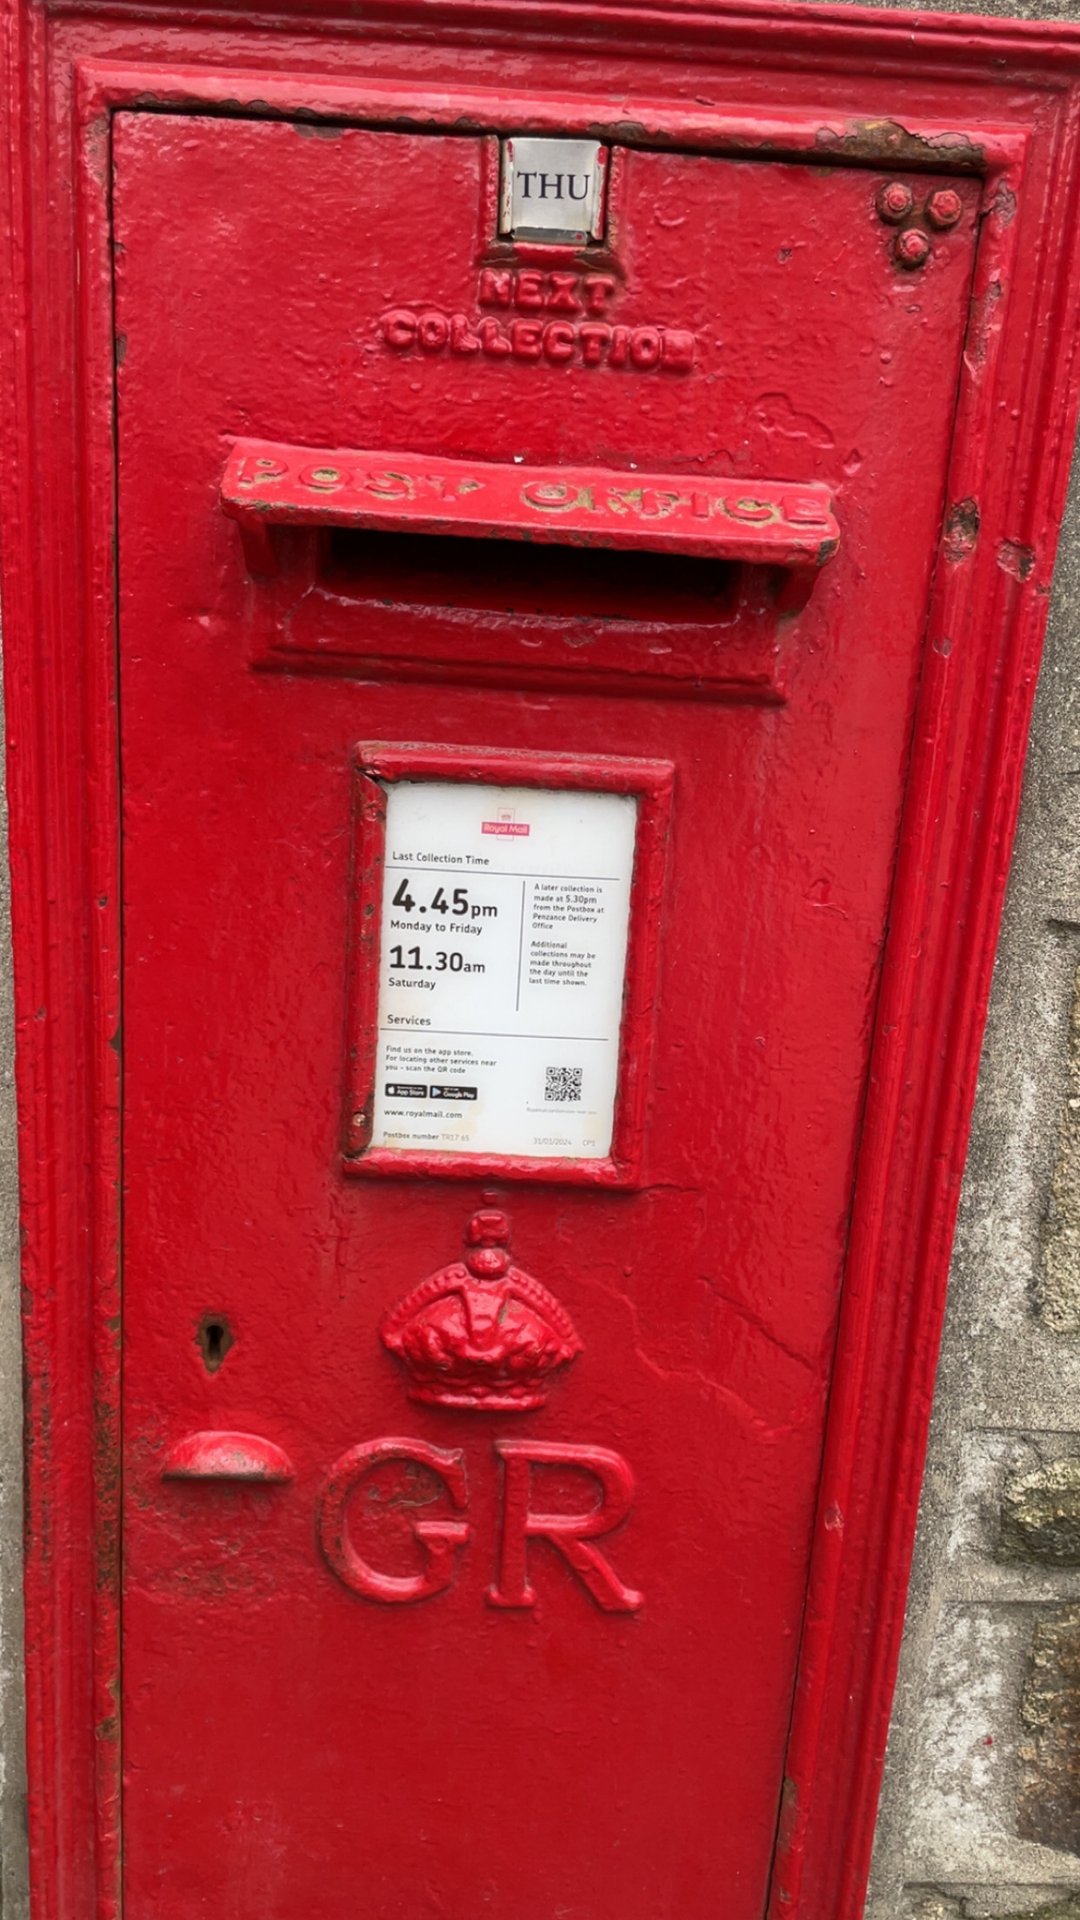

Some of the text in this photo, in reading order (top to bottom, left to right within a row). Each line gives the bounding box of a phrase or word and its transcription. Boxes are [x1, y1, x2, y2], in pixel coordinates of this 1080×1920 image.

[517, 171, 590, 199] THU
[478, 268, 615, 312] NEXT
[237, 456, 830, 529] POST OFFICE
[484, 824, 528, 834] Royal Mail
[392, 852, 490, 865] Last Collection Time
[560, 884, 594, 893] collection
[392, 878, 498, 919] 4.45pm
[566, 894, 597, 904] 5.30pm
[567, 905, 595, 913] Postbox
[532, 913, 597, 923] Penzance Delivery
[390, 920, 482, 936] Monday to Friday
[532, 922, 553, 930] Office
[531, 941, 567, 949] Additional
[390, 945, 486, 973] 11.30am
[530, 950, 568, 958] collections
[552, 960, 591, 969] throughout
[543, 969, 556, 977] day
[388, 978, 436, 991] Saturday
[387, 1014, 431, 1025] Services
[399, 1055, 427, 1064] locating
[429, 1056, 448, 1064] other
[384, 1109, 462, 1119] www.royalmail.com
[383, 1131, 410, 1139] Postbox
[317, 1436, 644, 1611] GR
